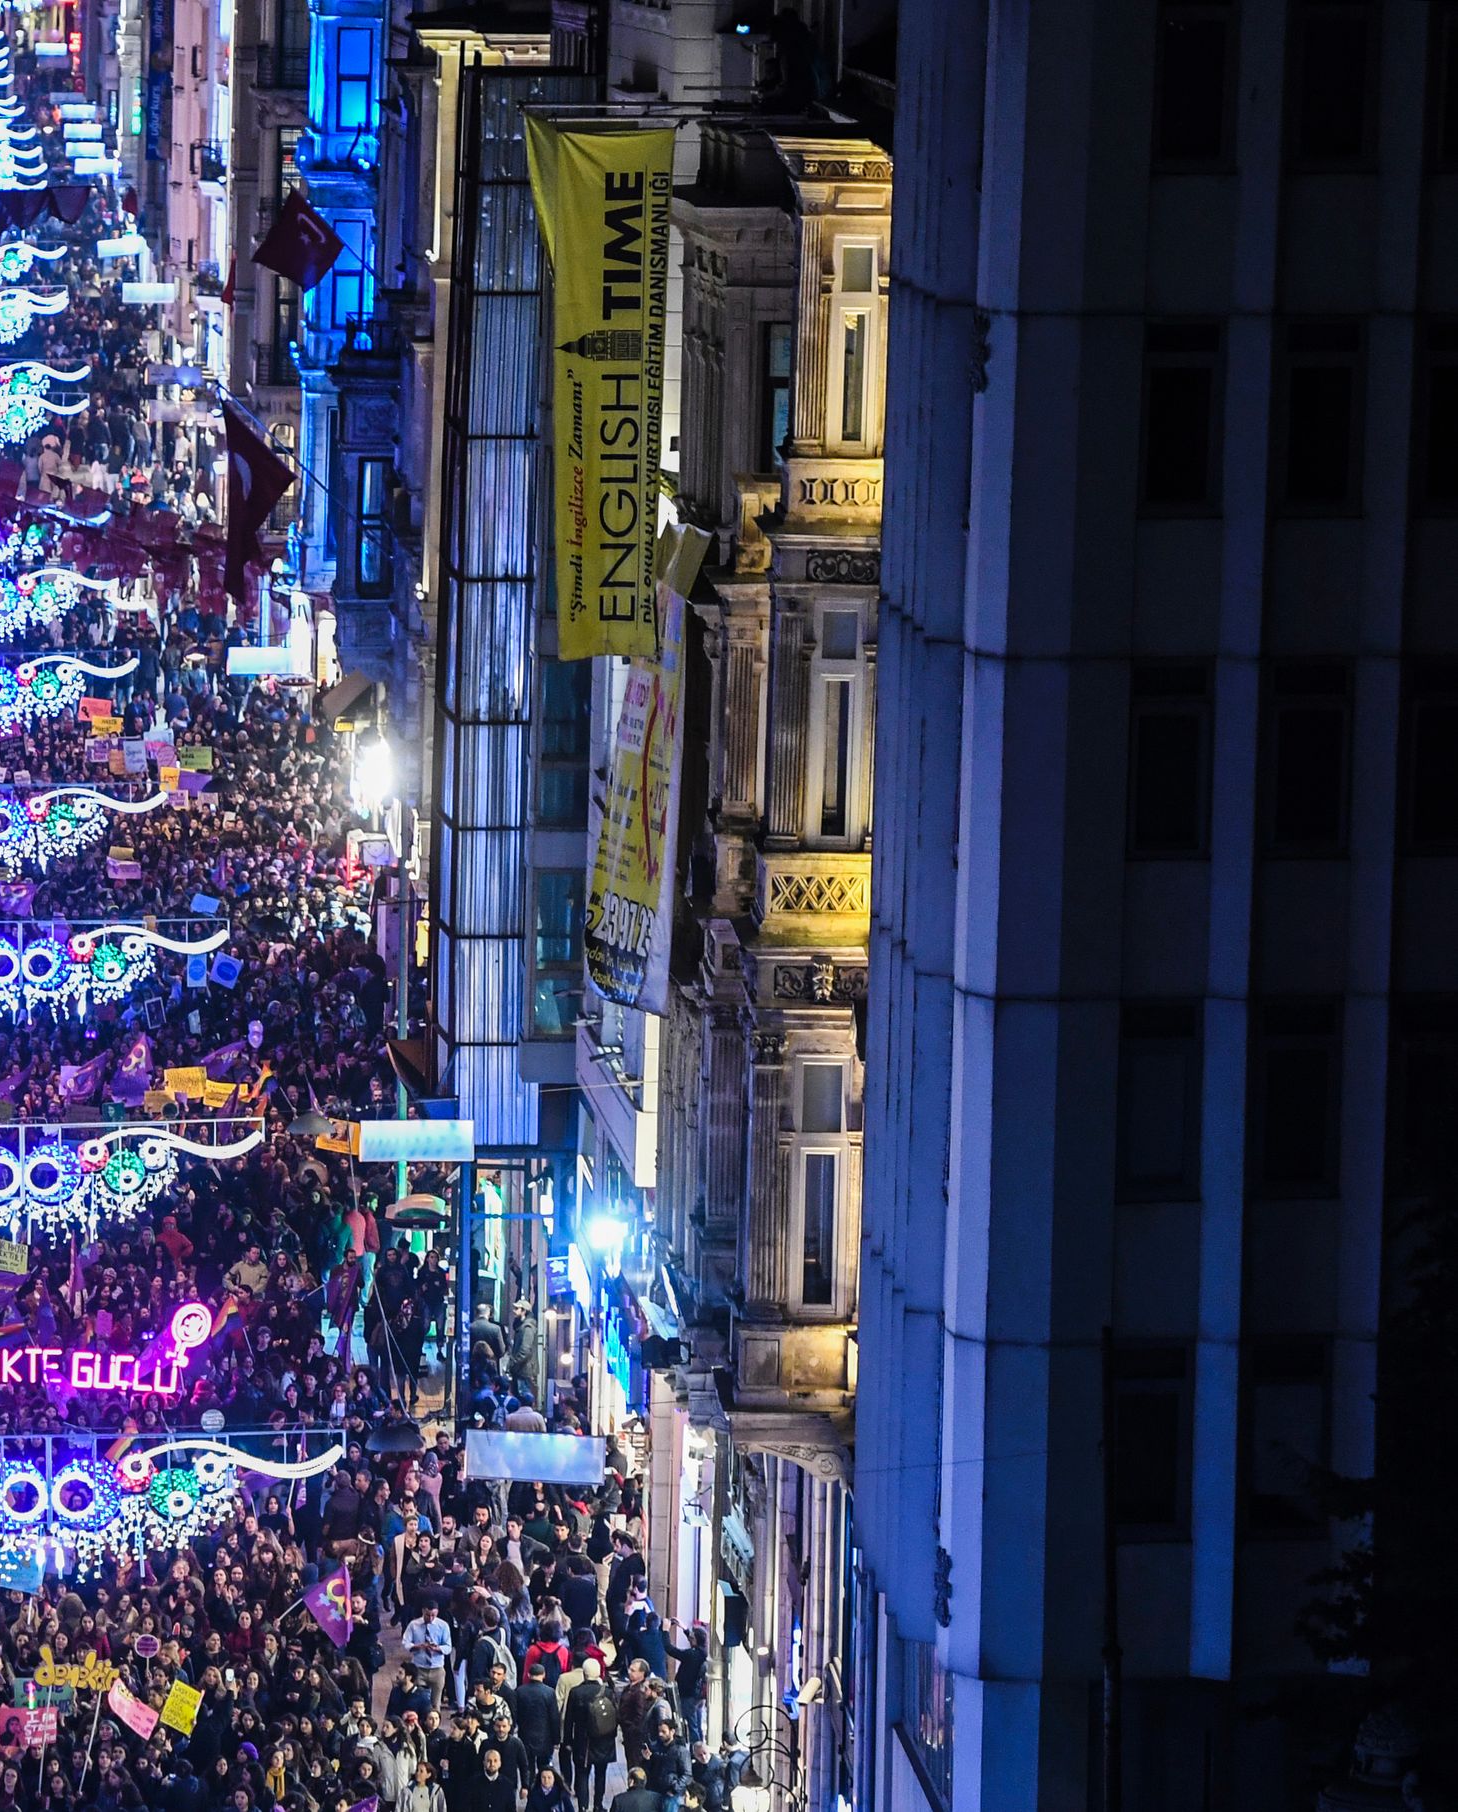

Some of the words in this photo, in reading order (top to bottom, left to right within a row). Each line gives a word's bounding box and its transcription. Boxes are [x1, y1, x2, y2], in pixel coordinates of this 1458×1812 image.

[602, 171, 644, 320] TIME
[566, 467, 587, 548] İngilizce
[599, 374, 640, 622] ENGLISH
